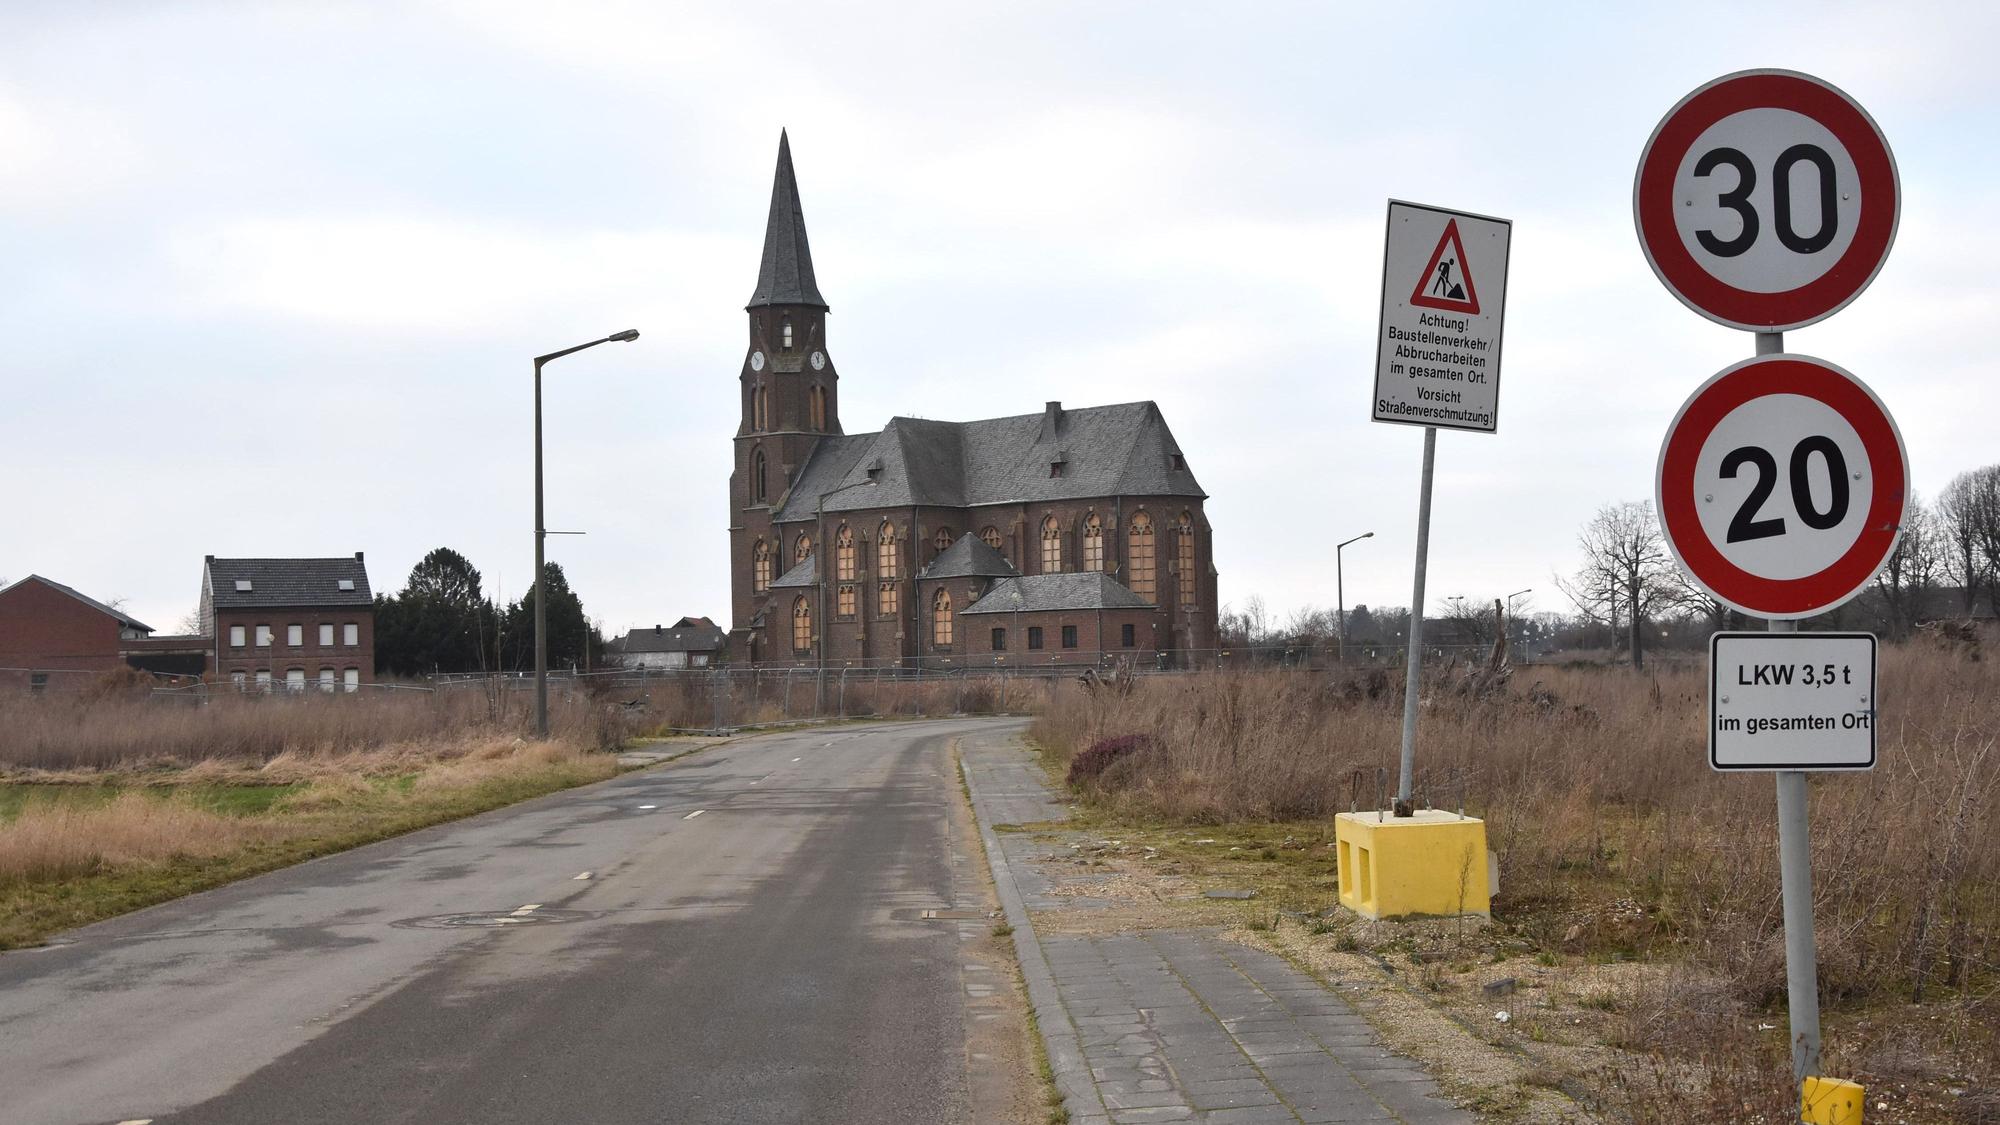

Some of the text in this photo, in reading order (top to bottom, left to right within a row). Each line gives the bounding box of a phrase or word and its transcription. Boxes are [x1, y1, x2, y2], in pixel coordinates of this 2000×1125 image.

[1693, 143, 1838, 258] 30
[1419, 312, 1469, 333] Achtung!
[1395, 345, 1486, 367] Abbrucharbeiten
[1390, 361, 1487, 384] im gesamten Ort.
[1417, 387, 1461, 404] Vorsicht
[1378, 399, 1494, 425] Straßenverschmutzung!
[1718, 434, 1850, 544] 20
[1738, 664, 1851, 688] LKW 3,5 t
[1718, 712, 1869, 735] im gesamten Ort
